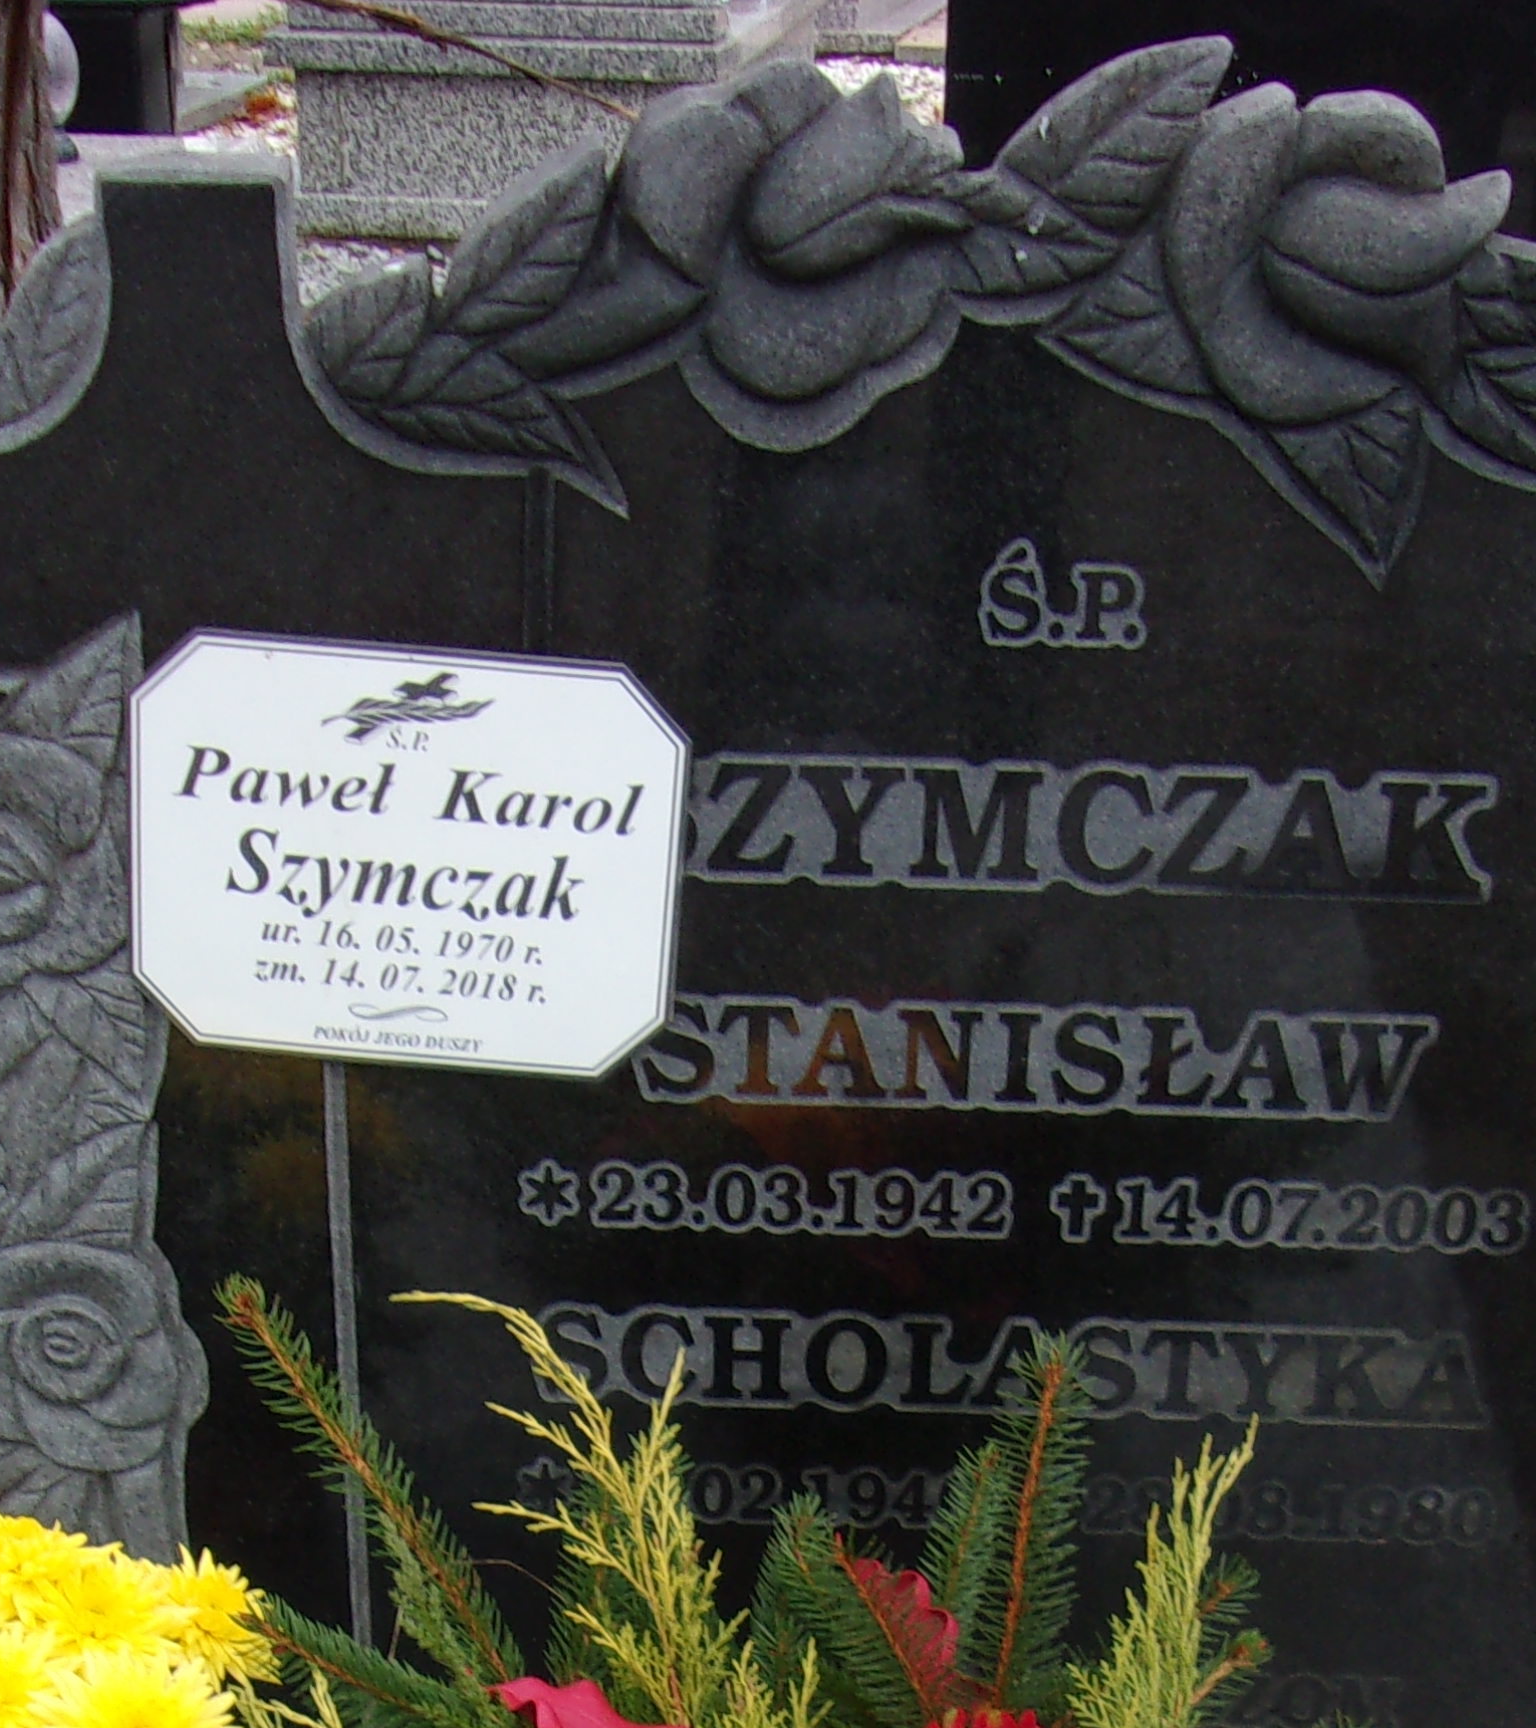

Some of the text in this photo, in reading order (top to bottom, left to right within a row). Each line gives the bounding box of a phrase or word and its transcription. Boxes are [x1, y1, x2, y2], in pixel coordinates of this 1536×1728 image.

[172, 744, 644, 837] Paweł Karol
[686, 755, 1498, 903] ZYMCZAK
[226, 827, 585, 921] Szymczak
[254, 958, 547, 1004] zm. 14. 07. 2018 r.
[261, 919, 544, 965] ur. 16. 05. 1970 r.
[314, 1023, 484, 1053] POKÓJ JEGO DUSZY
[634, 995, 1438, 1122] STANISŁAW
[589, 1159, 1530, 1256] 23.03.1942 14.07.2003
